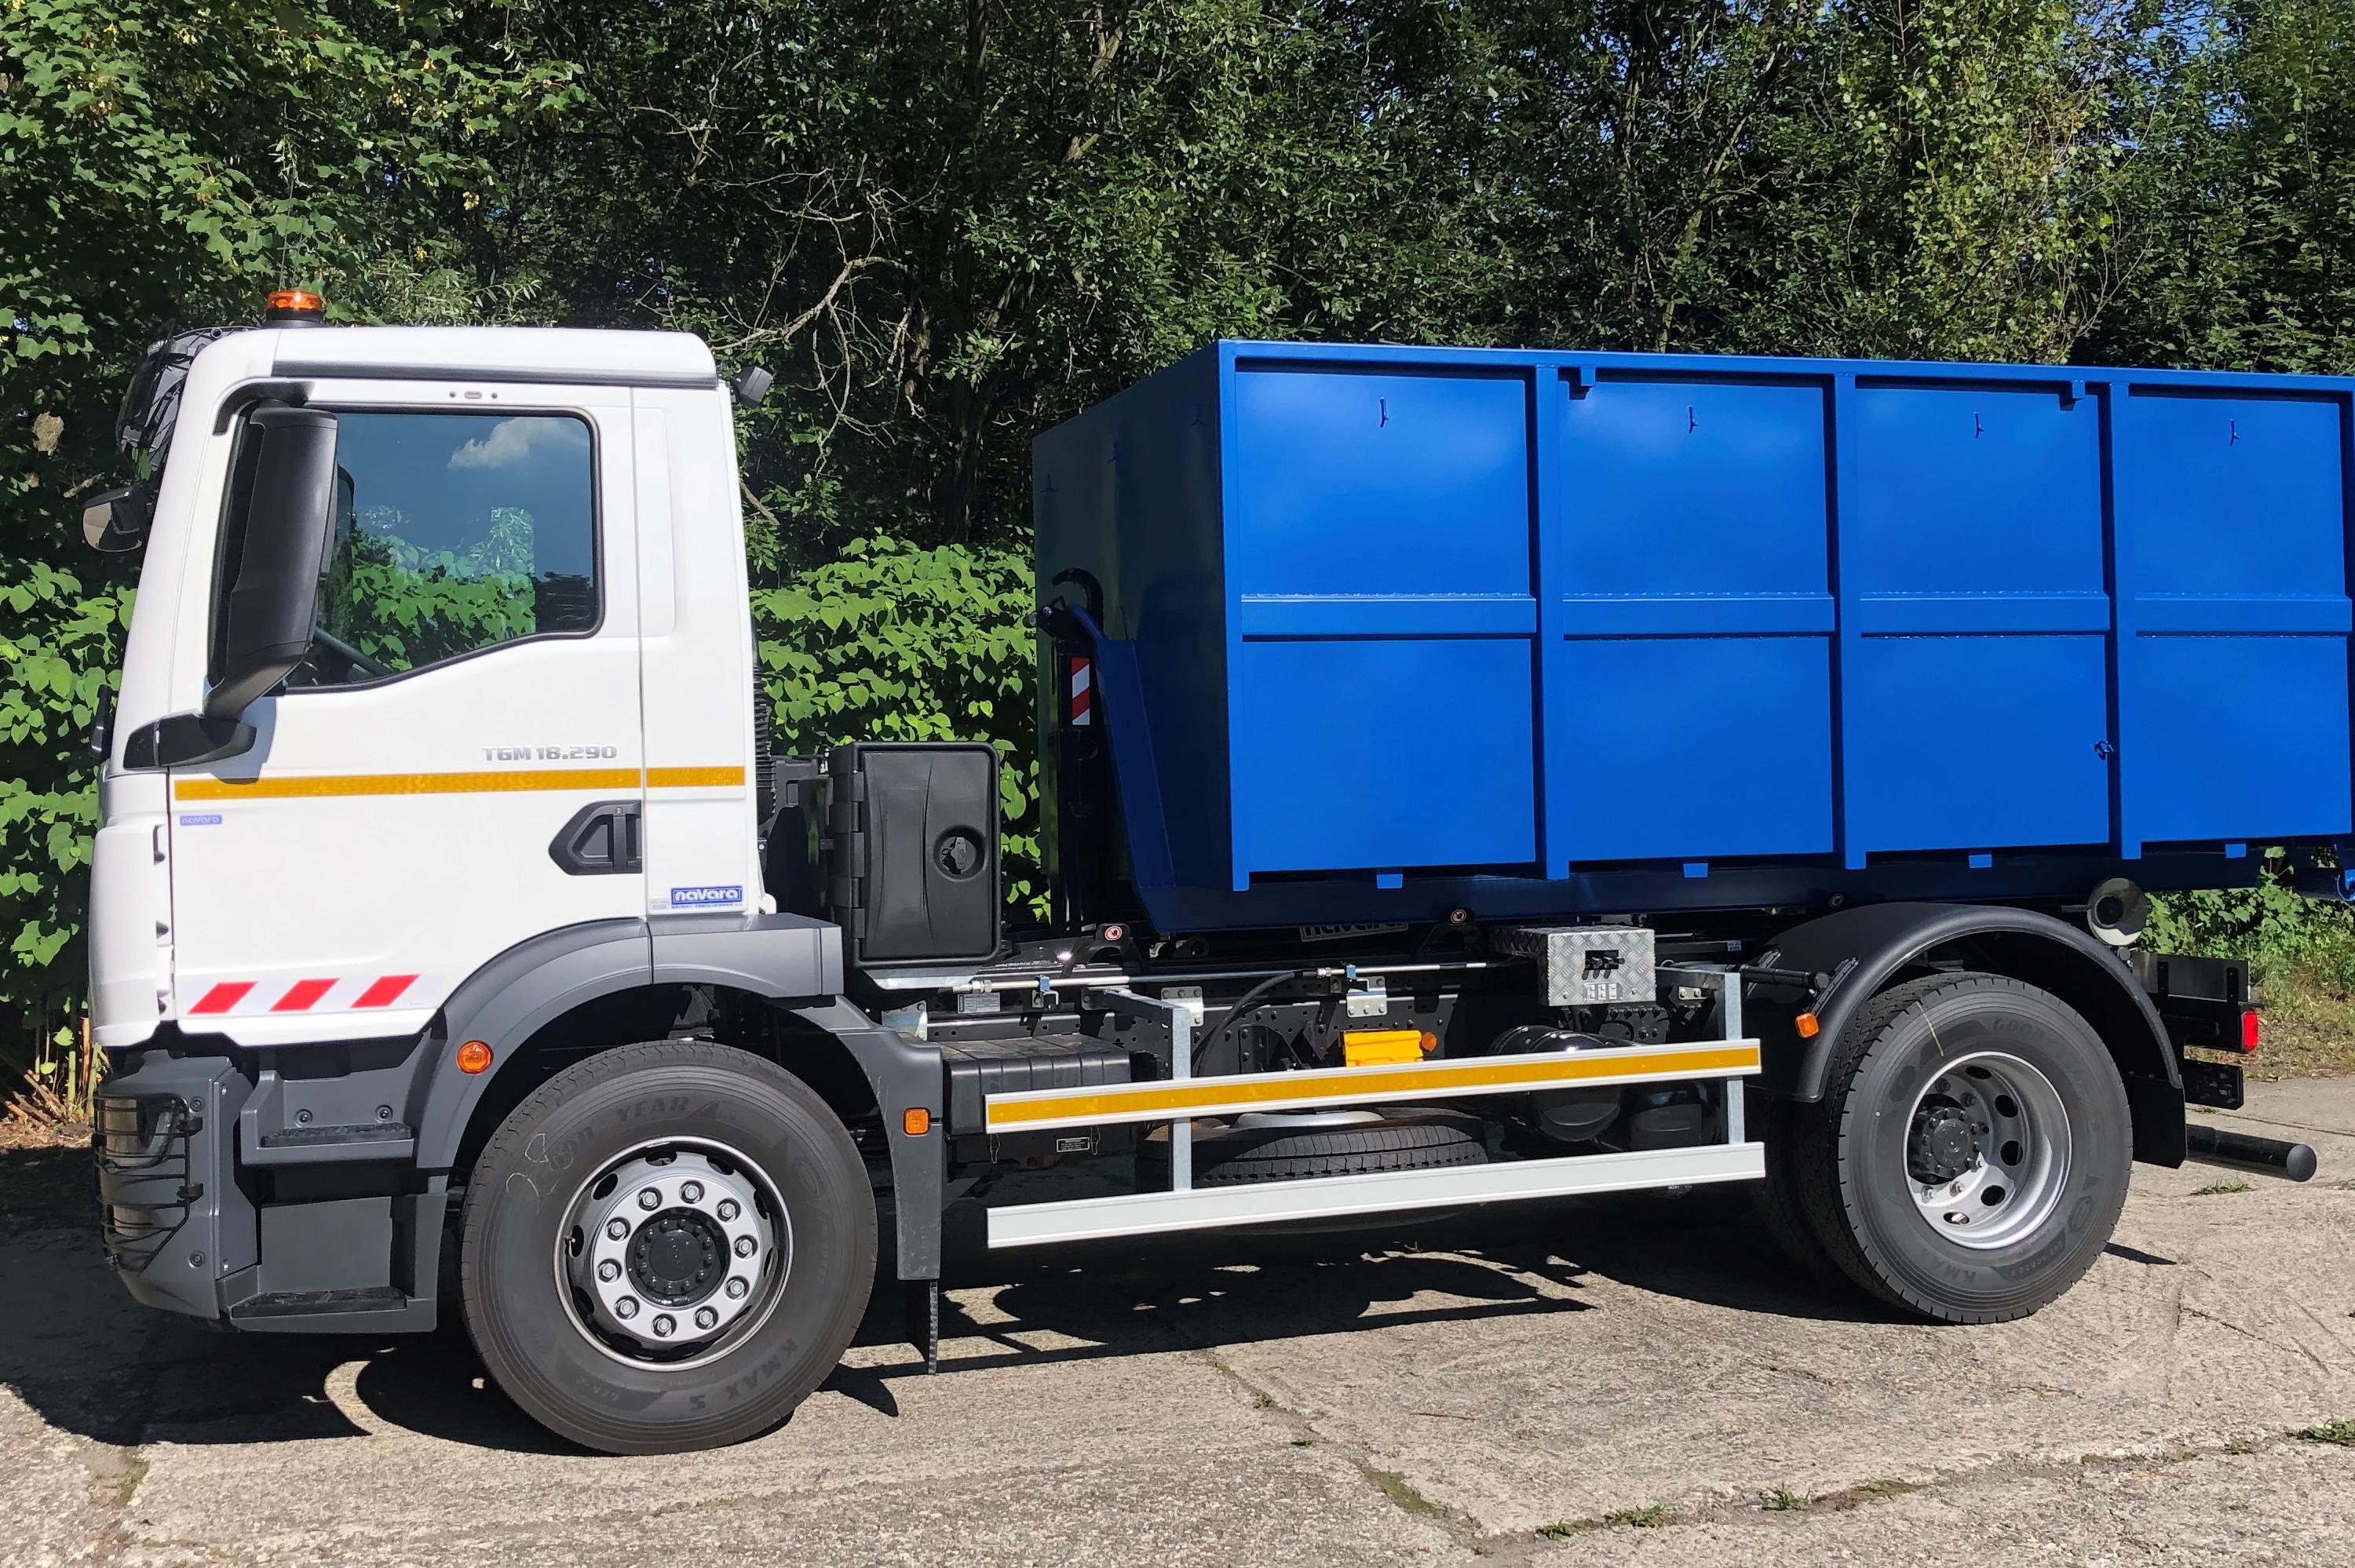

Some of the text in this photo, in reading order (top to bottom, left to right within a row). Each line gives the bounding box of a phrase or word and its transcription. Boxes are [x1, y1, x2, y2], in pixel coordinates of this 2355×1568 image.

[482, 746, 617, 760] TGM 18.290
[674, 888, 739, 902] navara
